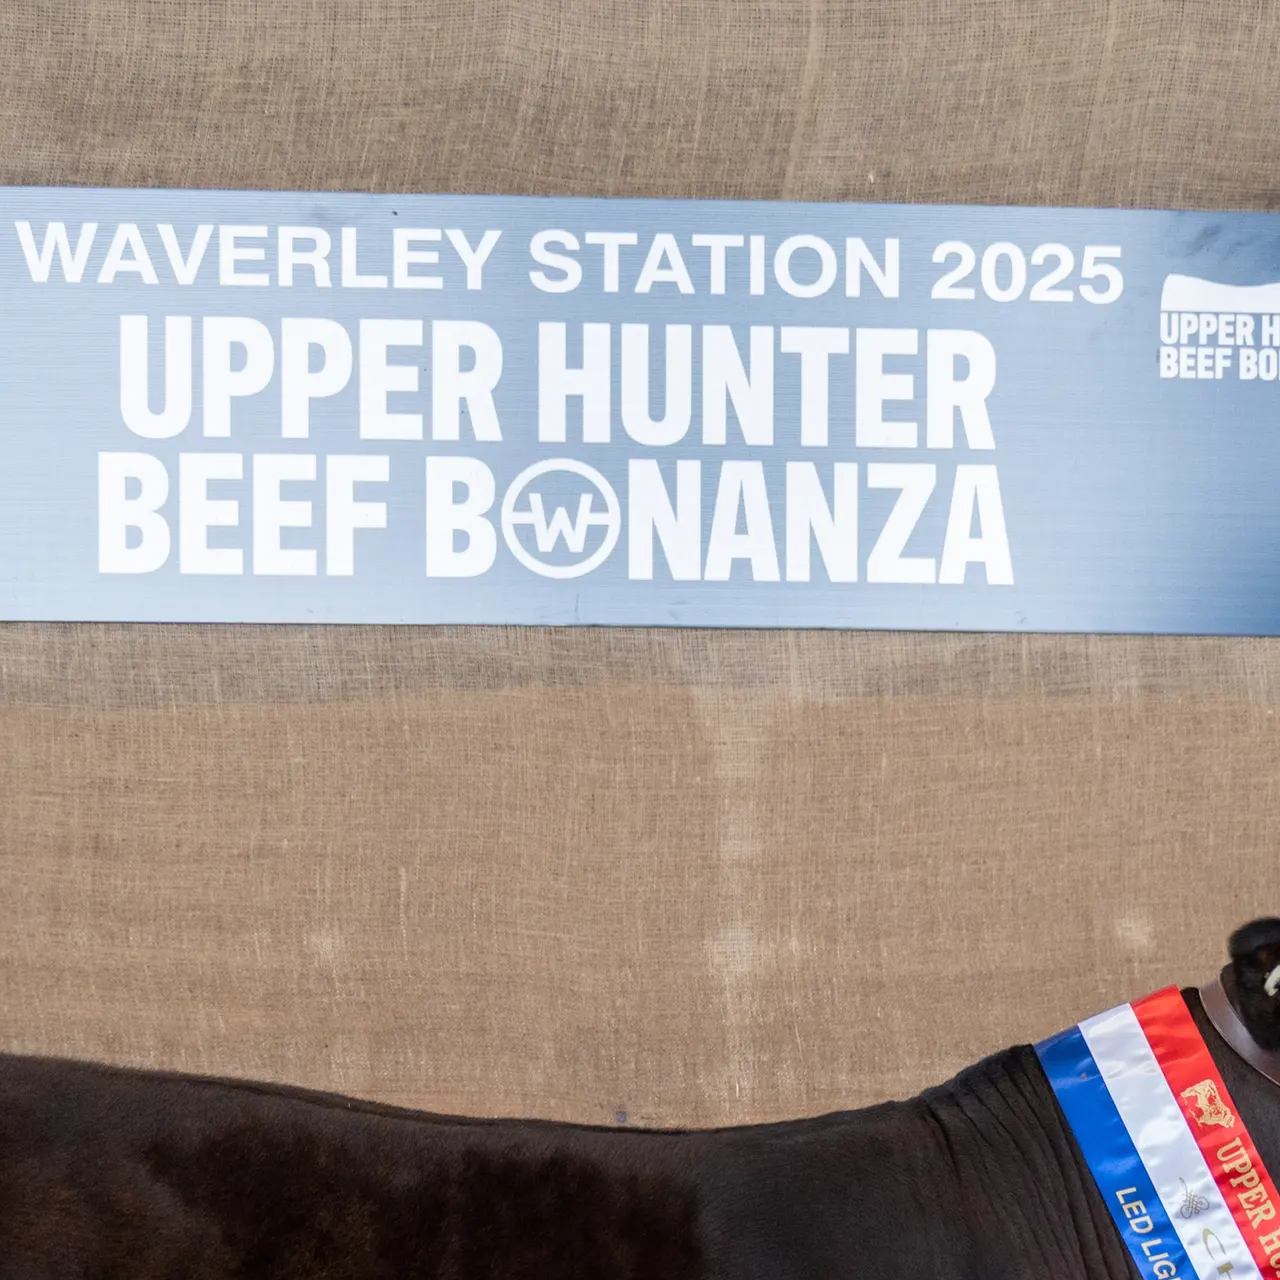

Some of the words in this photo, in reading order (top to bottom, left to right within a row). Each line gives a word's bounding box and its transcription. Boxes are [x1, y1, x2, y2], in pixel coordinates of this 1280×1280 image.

[15, 221, 501, 290] WAVERLEY
[529, 229, 900, 298] STATION
[931, 241, 1124, 304] 2025
[1160, 312, 1255, 345] UPPER
[1160, 346, 1233, 379] BEEF
[119, 315, 503, 441] UPPER
[538, 322, 997, 450] HUNTER
[97, 451, 390, 576] BEEF
[1115, 1186, 1154, 1234] LED
[1216, 1137, 1276, 1229] UPPER
